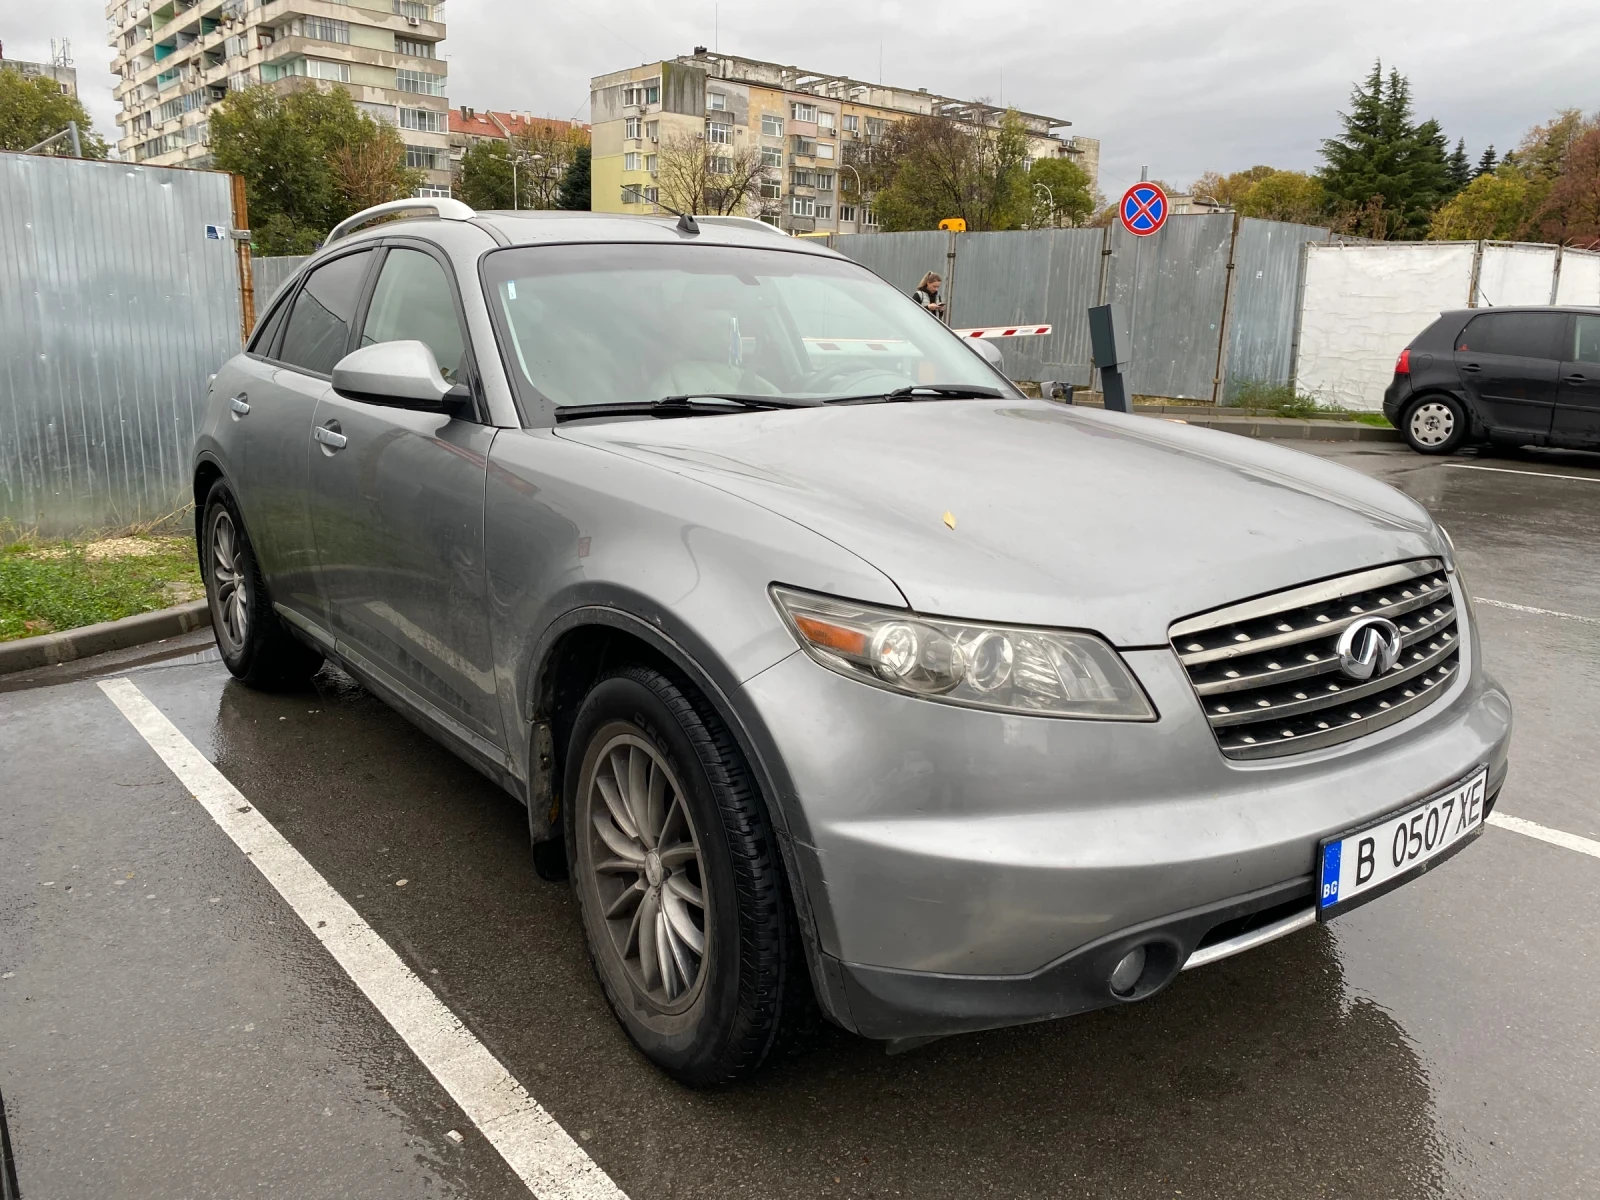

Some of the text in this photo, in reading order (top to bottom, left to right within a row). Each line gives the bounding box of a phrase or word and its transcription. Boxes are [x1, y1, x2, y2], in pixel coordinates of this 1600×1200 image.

[1356, 778, 1483, 887] B 0507 XE
[1323, 880, 1338, 898] BG
